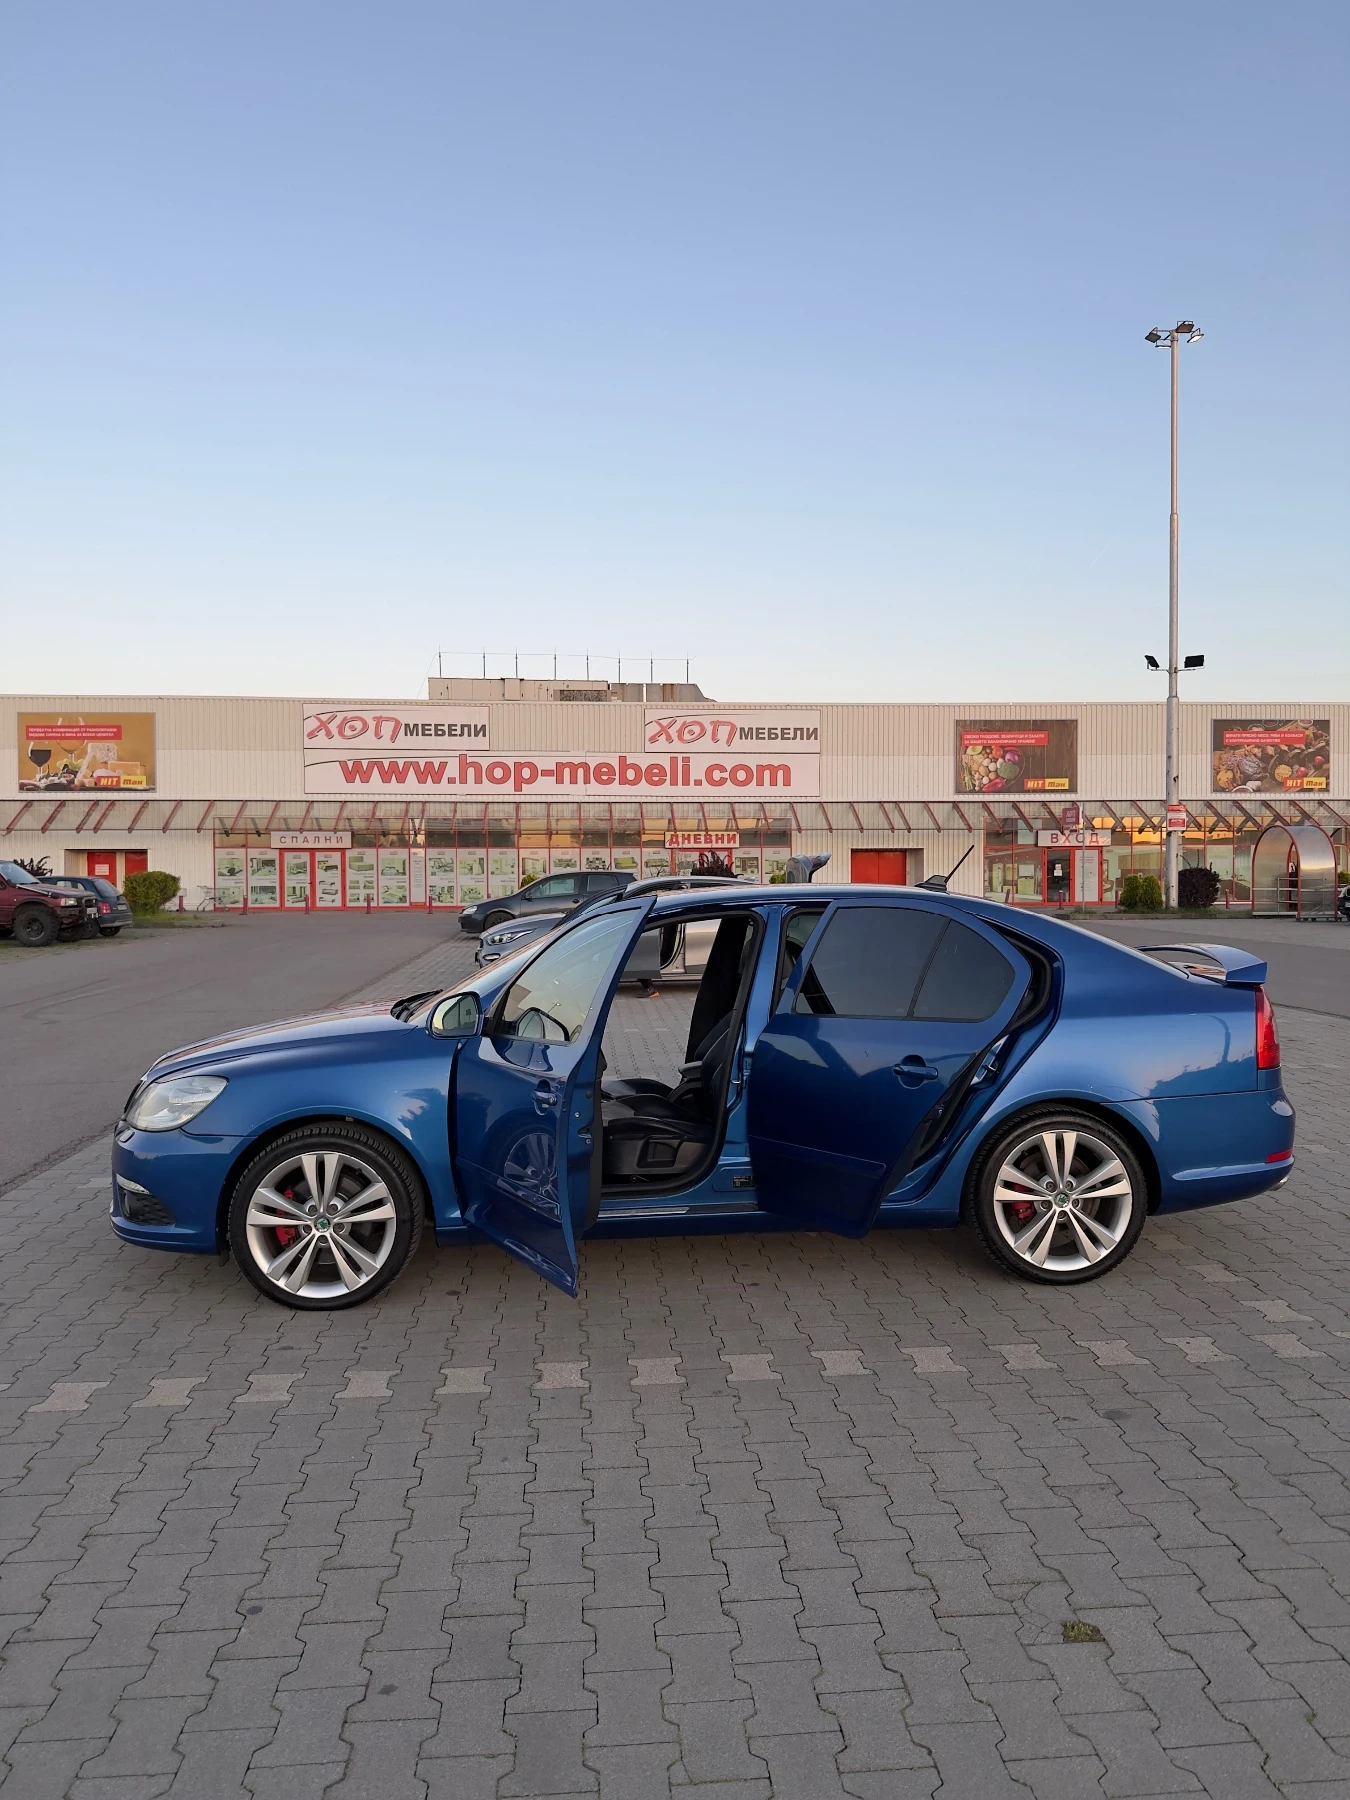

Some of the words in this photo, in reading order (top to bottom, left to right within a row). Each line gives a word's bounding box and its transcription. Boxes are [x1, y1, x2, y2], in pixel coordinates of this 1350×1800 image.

[306, 713, 402, 743] ХОП
[404, 723, 487, 737] МЕБЕЛИ
[648, 717, 738, 747] ХОП
[739, 727, 818, 741] МЕБЕЛИ
[339, 754, 791, 792] www.hop-mebeli.com
[100, 777, 118, 786] HIT
[1027, 780, 1043, 788] HIT
[1286, 779, 1302, 787] HIT
[279, 836, 343, 844] СПАЛНИ
[669, 834, 737, 847] ДНЕВНИ
[1050, 833, 1099, 845] ВХОД
